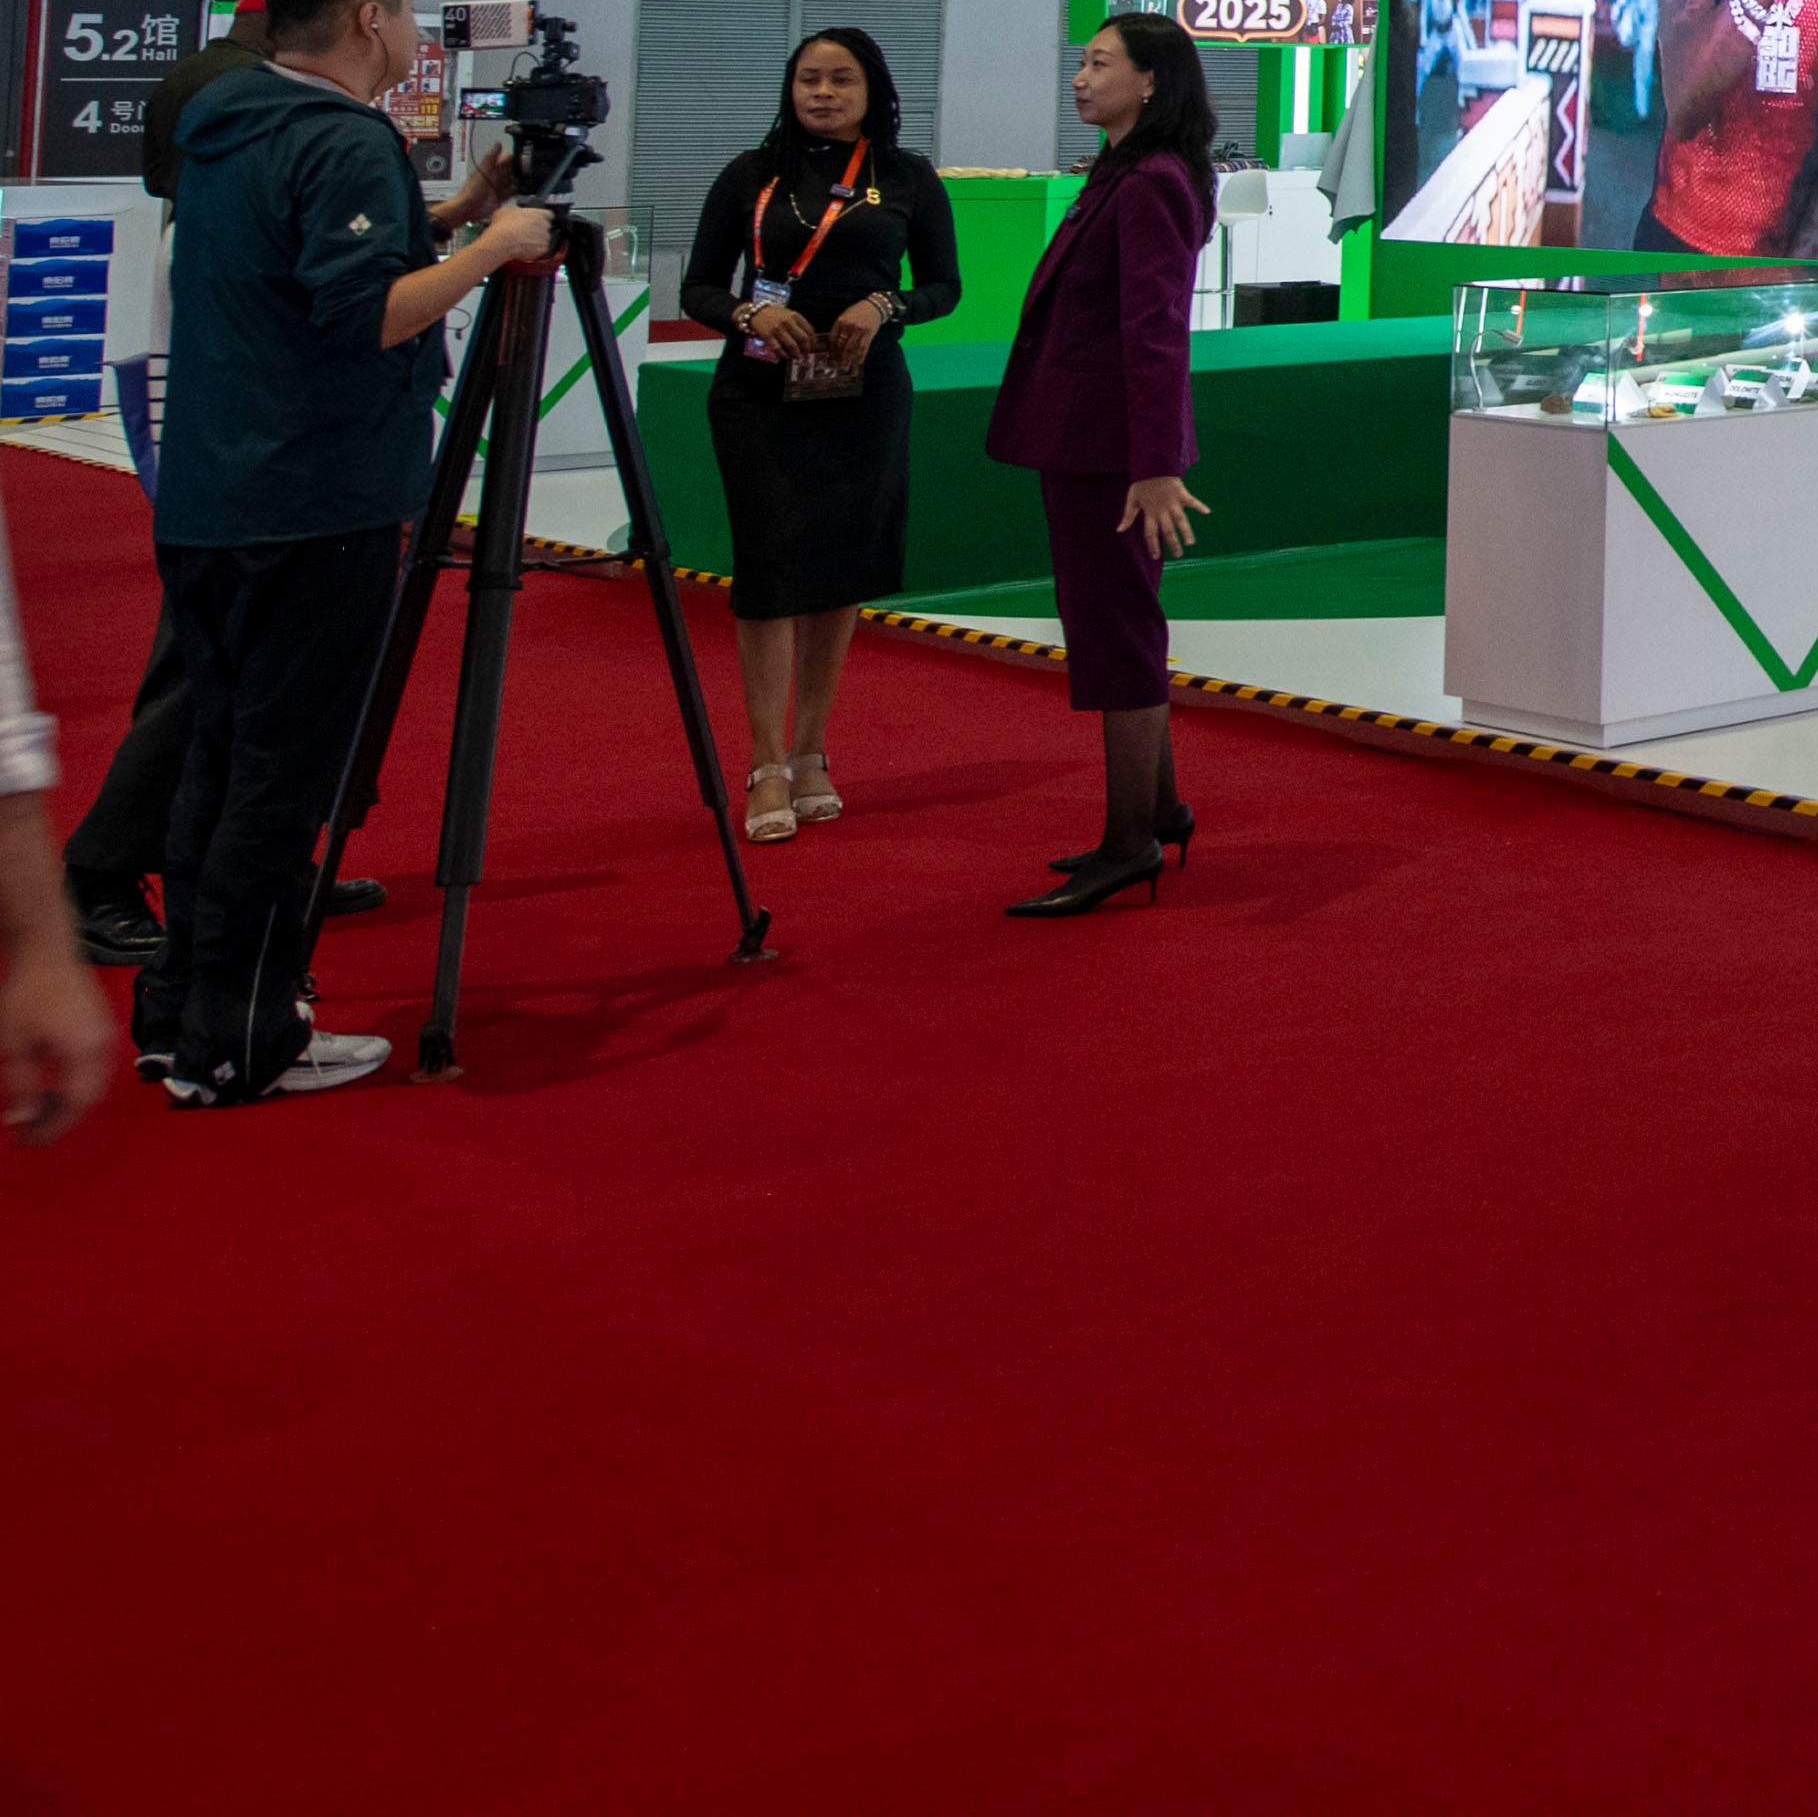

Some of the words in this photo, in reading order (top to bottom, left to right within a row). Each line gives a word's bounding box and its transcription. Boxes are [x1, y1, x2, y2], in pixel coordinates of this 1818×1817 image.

[63, 13, 140, 62] 5.2
[141, 14, 180, 46] 馆
[142, 48, 177, 61] Hall
[72, 100, 103, 133] 4
